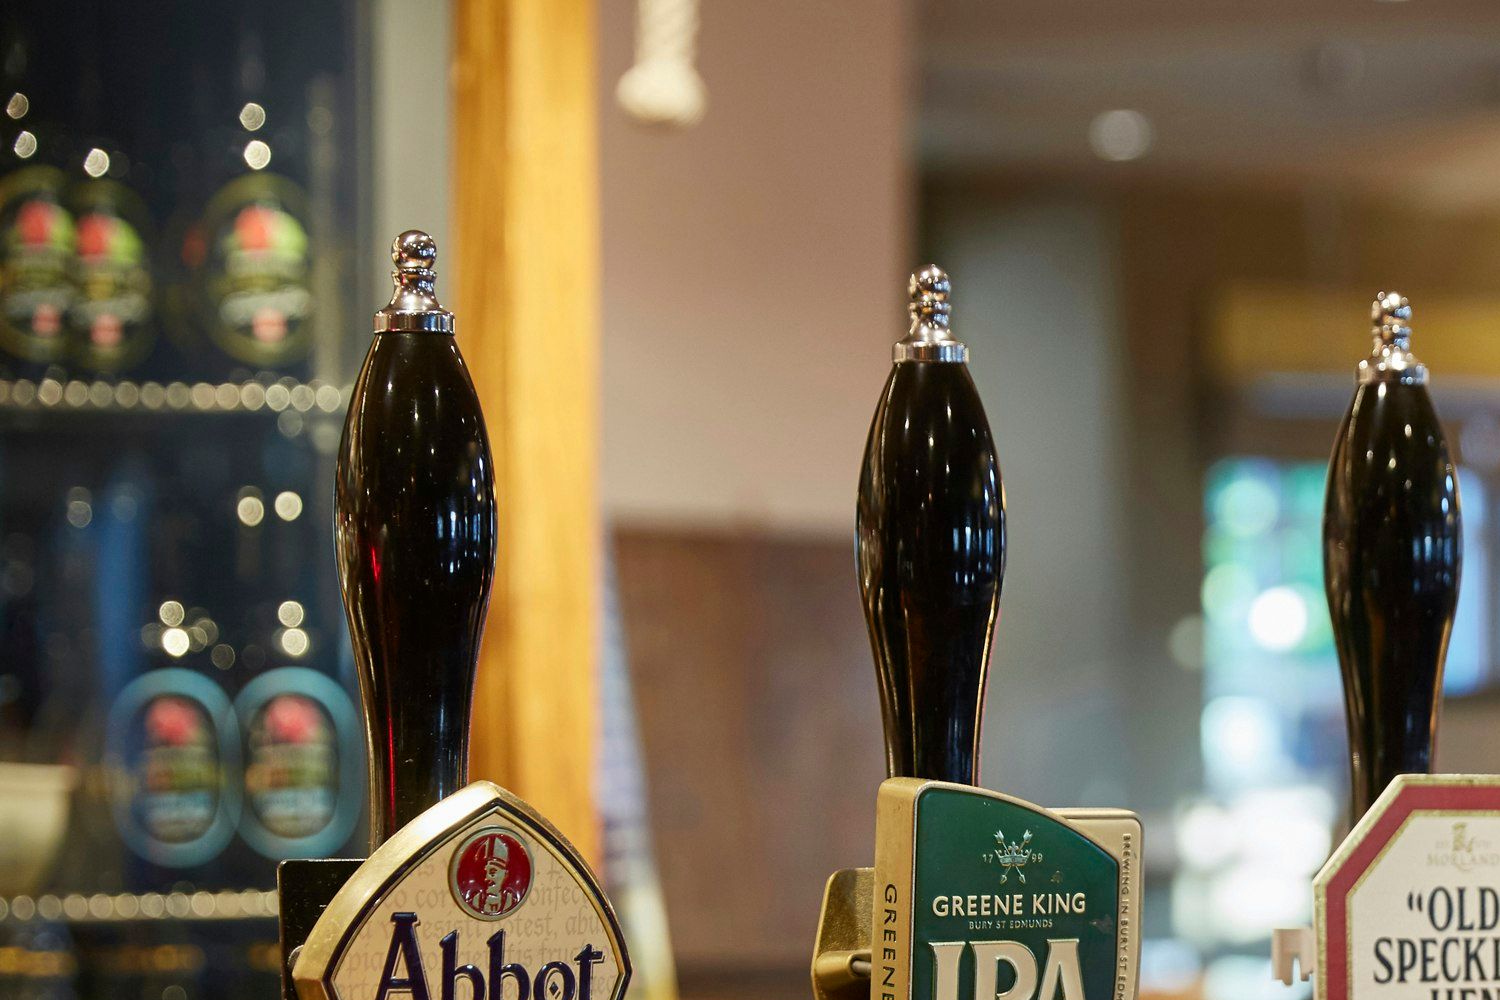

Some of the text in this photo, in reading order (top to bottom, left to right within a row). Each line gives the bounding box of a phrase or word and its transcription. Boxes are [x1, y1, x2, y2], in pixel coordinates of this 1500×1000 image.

[982, 852, 1043, 864] 17 99
[1121, 833, 1131, 895] BREWING
[932, 892, 1086, 917] GREENE KING
[1121, 899, 1129, 914] IN
[969, 918, 1053, 930] BURY ST EDMUNDS
[1120, 918, 1128, 951] BURY
[1119, 956, 1128, 971] ST
